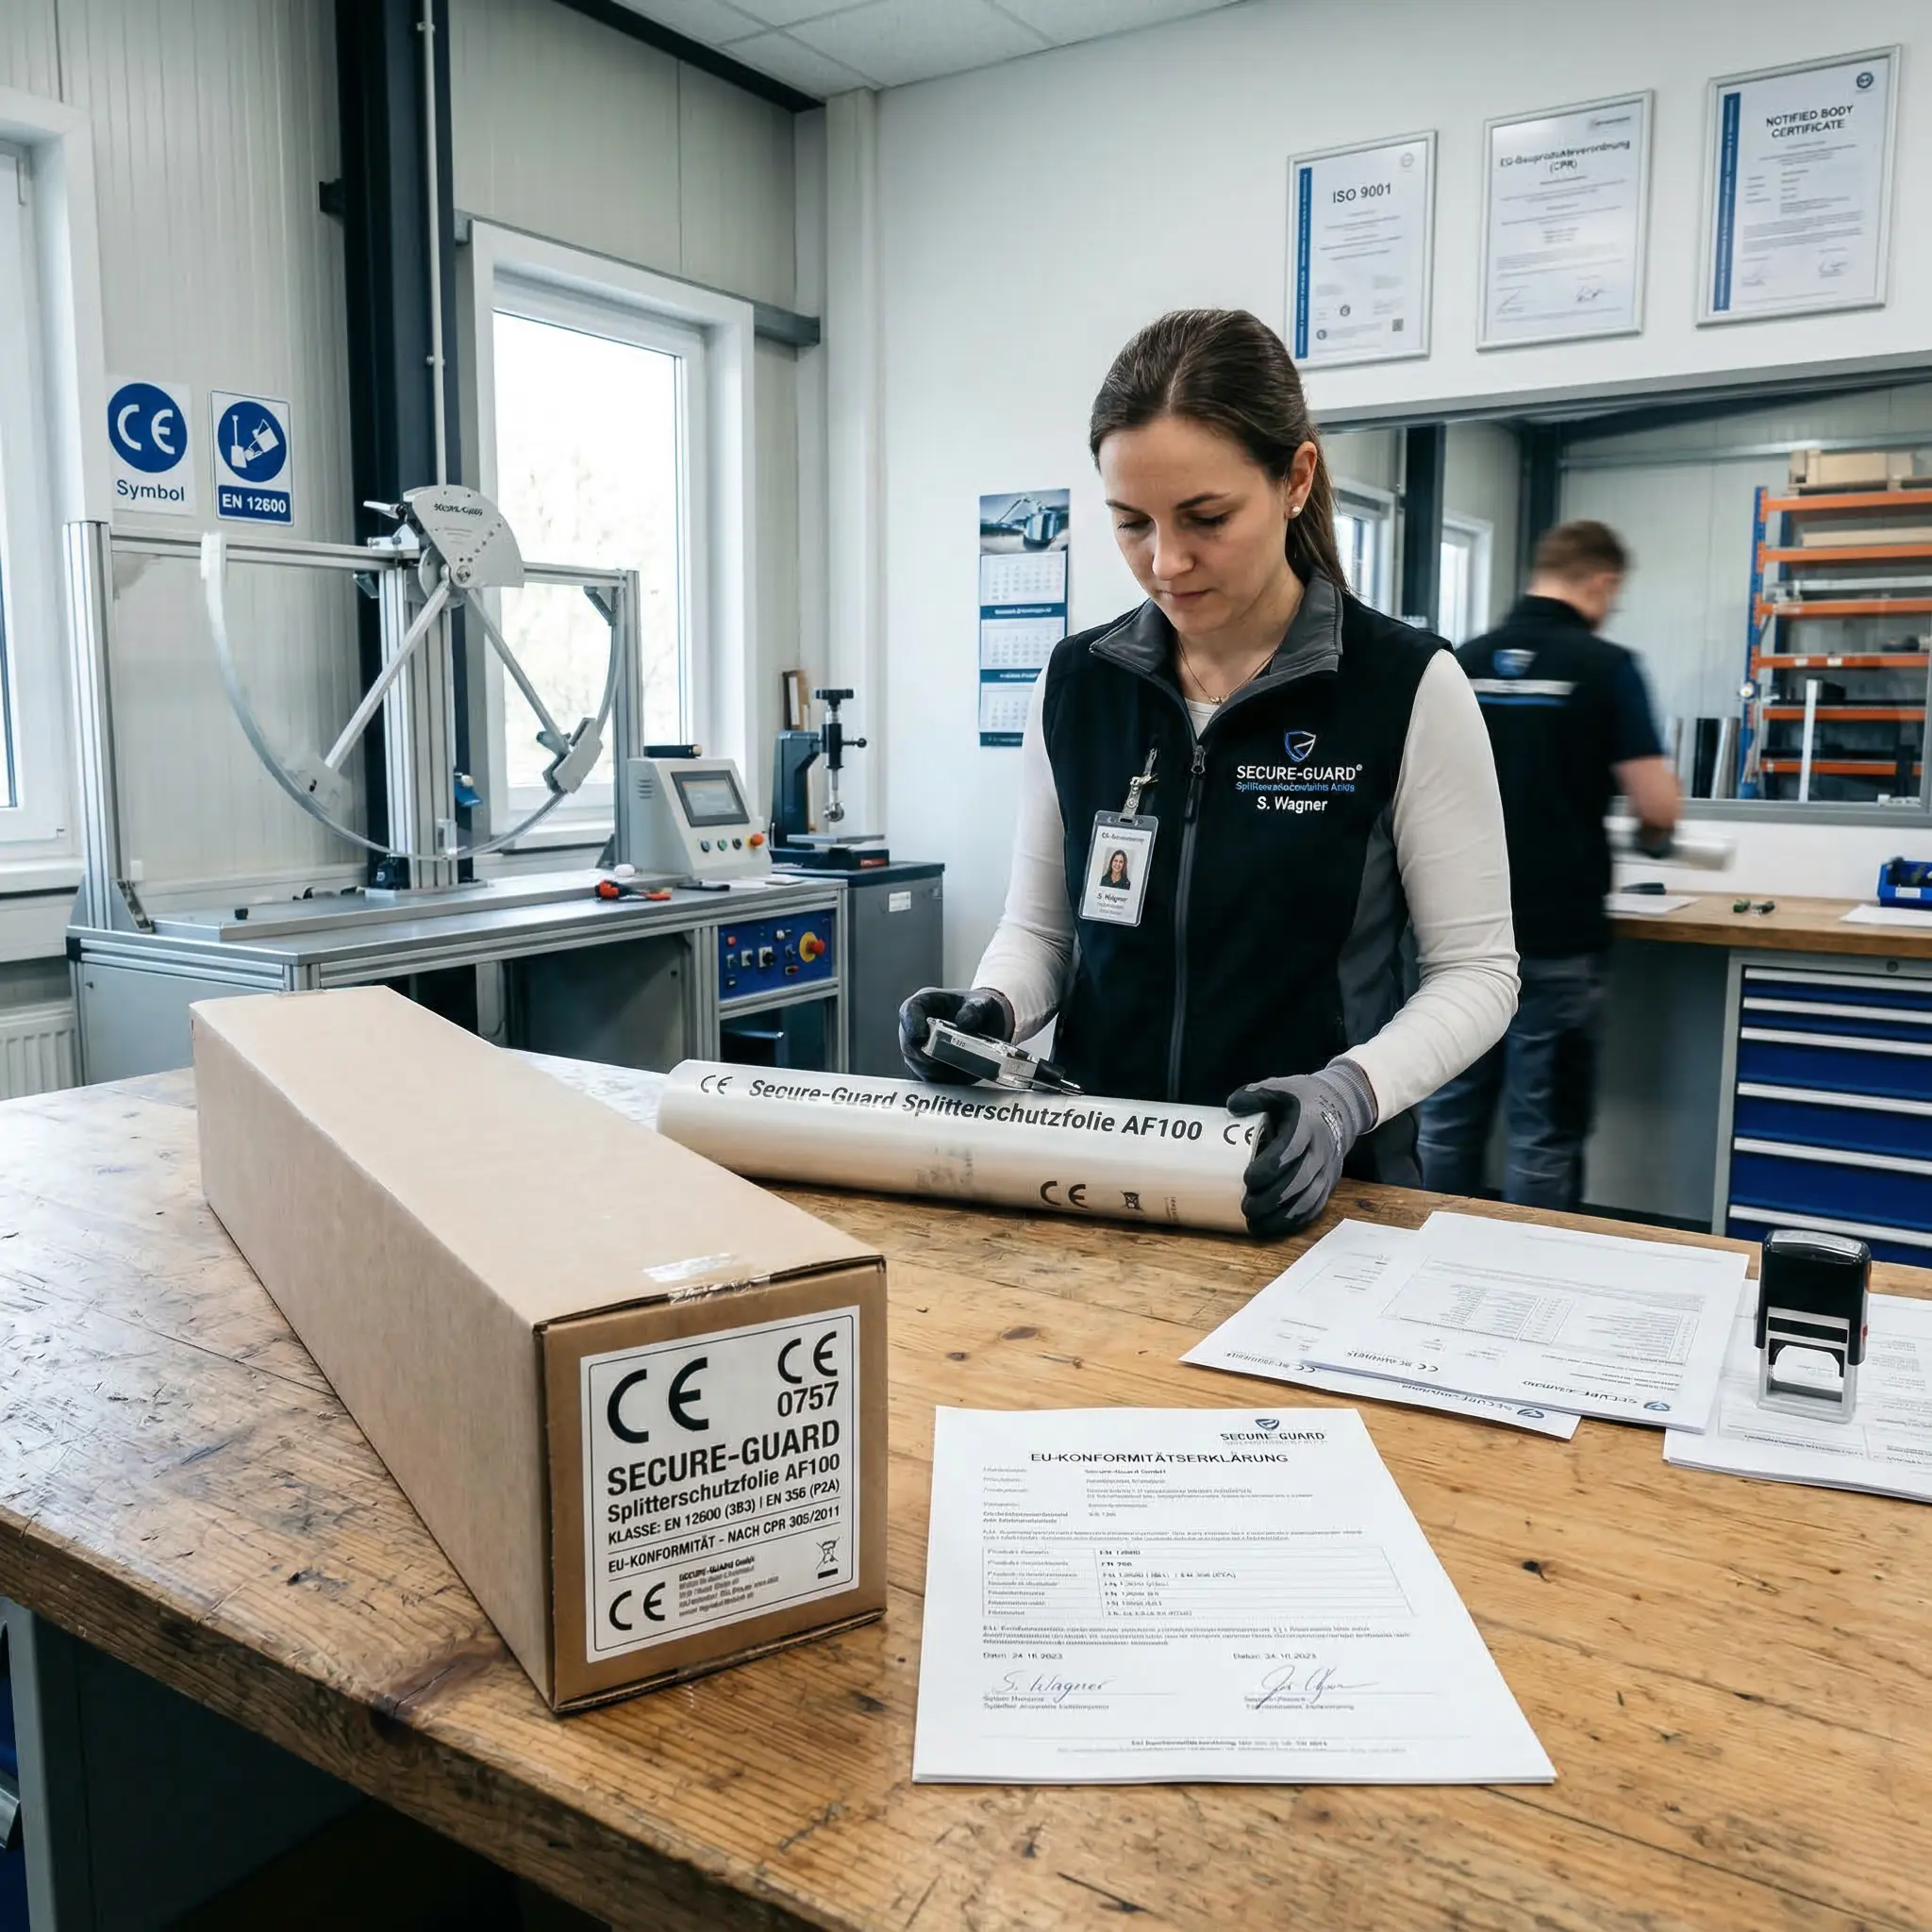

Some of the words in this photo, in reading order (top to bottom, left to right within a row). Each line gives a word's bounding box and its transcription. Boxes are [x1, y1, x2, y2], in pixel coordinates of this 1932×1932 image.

[1766, 109, 1818, 127] NOTIFIED
[1821, 105, 1854, 119] BODY
[1772, 119, 1845, 139] CERTIFICATE
[1332, 188, 1357, 204] ISO
[1360, 183, 1391, 199] 9001
[117, 404, 175, 455] CE
[116, 479, 185, 501] Symbol
[222, 493, 242, 508] EN
[246, 496, 287, 514] 12600
[1257, 795, 1271, 810] S.
[1274, 796, 1327, 814] Wagner
[701, 1074, 733, 1095] CE
[749, 1079, 897, 1109] Secure-Guard
[902, 1093, 1115, 1132] Splitterschutzfolie
[1122, 1115, 1203, 1141] AF100
[1041, 1180, 1088, 1209] CE
[777, 1331, 838, 1384] CE
[607, 1357, 709, 1444] CE
[777, 1381, 839, 1418] 0757
[607, 1419, 840, 1497] SECURE-GUARD
[1031, 1451, 1289, 1463] EU-KONFORMITÄTSERKLÄRUNG
[608, 1469, 779, 1524] Splitterschutzfolie
[785, 1453, 840, 1482] AF100
[608, 1522, 660, 1545] KLASSE:
[665, 1517, 681, 1531] EN
[685, 1507, 721, 1526] 12600
[724, 1498, 755, 1520] (3B3)
[766, 1492, 782, 1507] EN
[785, 1487, 807, 1502] 356
[809, 1478, 840, 1499] (P2A)
[608, 1535, 715, 1574] EU-KONFORMITÄT
[727, 1525, 759, 1543] NACH
[763, 1518, 786, 1535] CPR
[789, 1505, 840, 1527] 305/2011
[608, 1581, 665, 1631] CE
